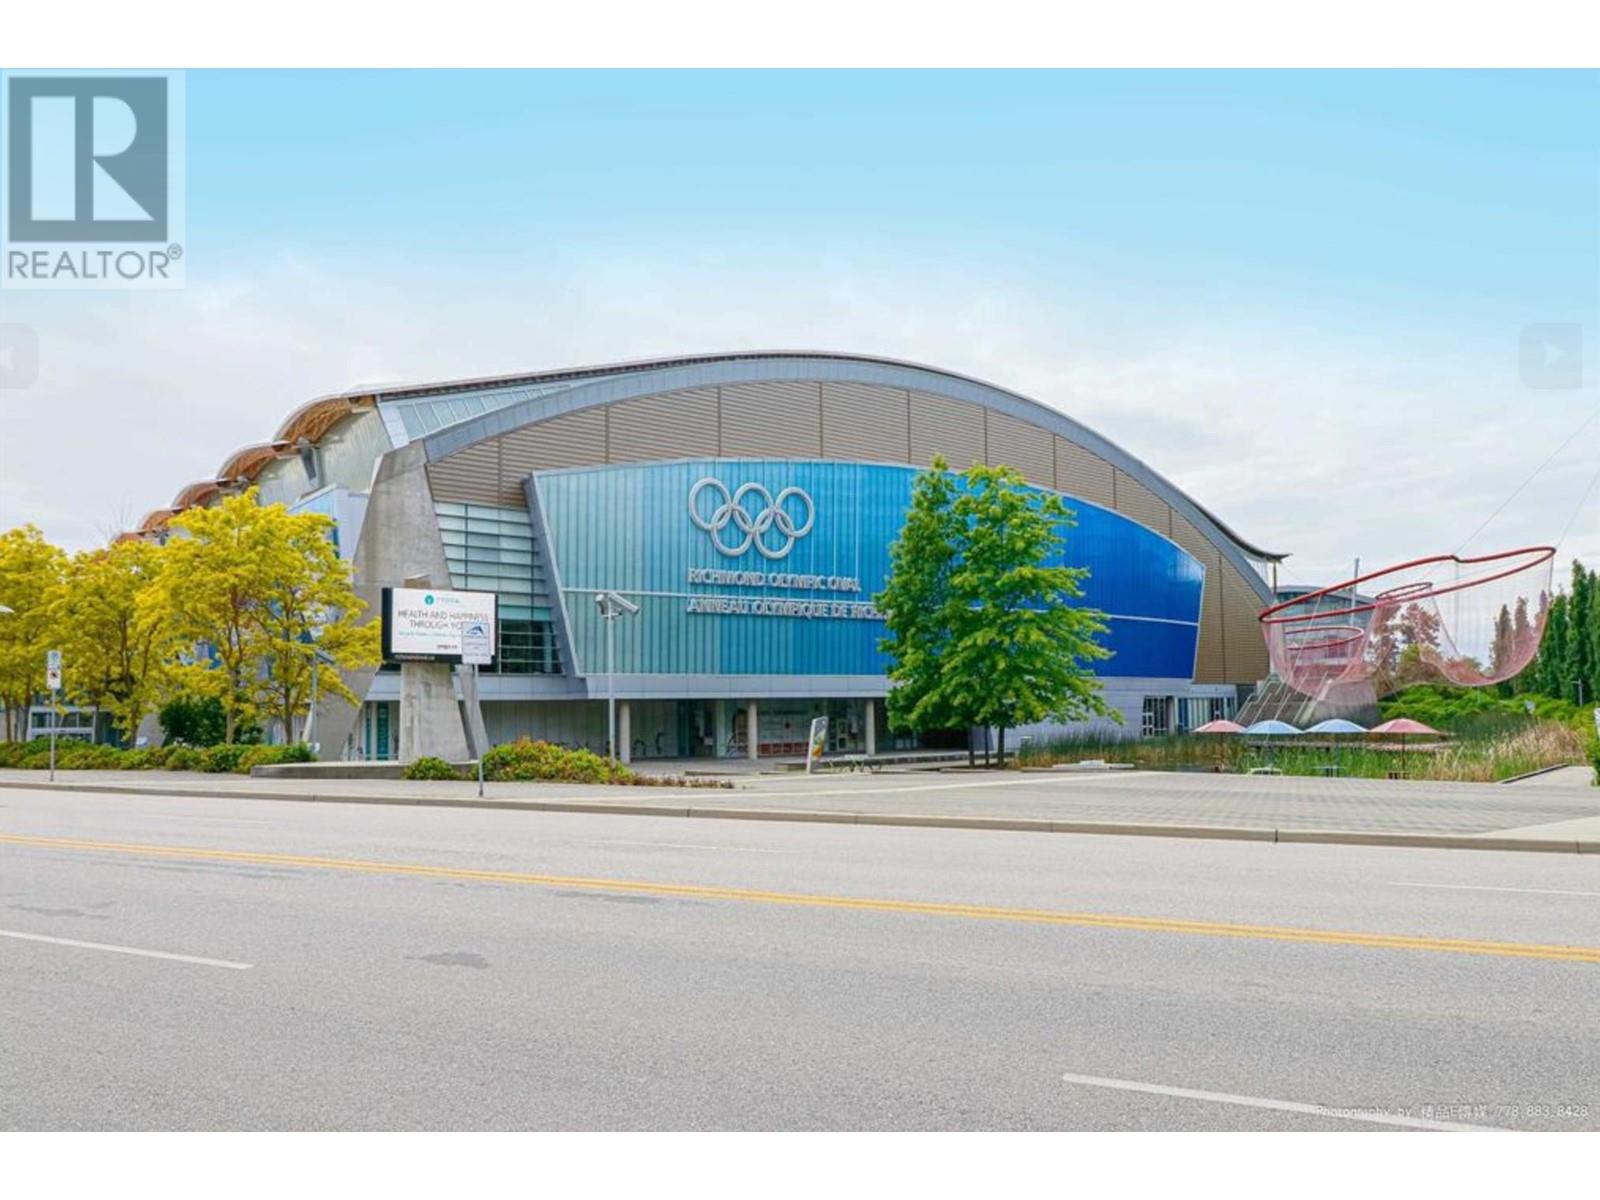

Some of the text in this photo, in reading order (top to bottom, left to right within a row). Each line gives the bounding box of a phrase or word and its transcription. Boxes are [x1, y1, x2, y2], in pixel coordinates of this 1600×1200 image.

[688, 568, 861, 592] RICHMOND OLYMPIC OVAL
[398, 610, 428, 618] HEALTH
[430, 611, 447, 620] AND
[687, 598, 749, 614] ANNEAU
[753, 600, 830, 619] OLYMPIQUE
[831, 603, 851, 618] DE
[409, 620, 448, 629] THROUGH
